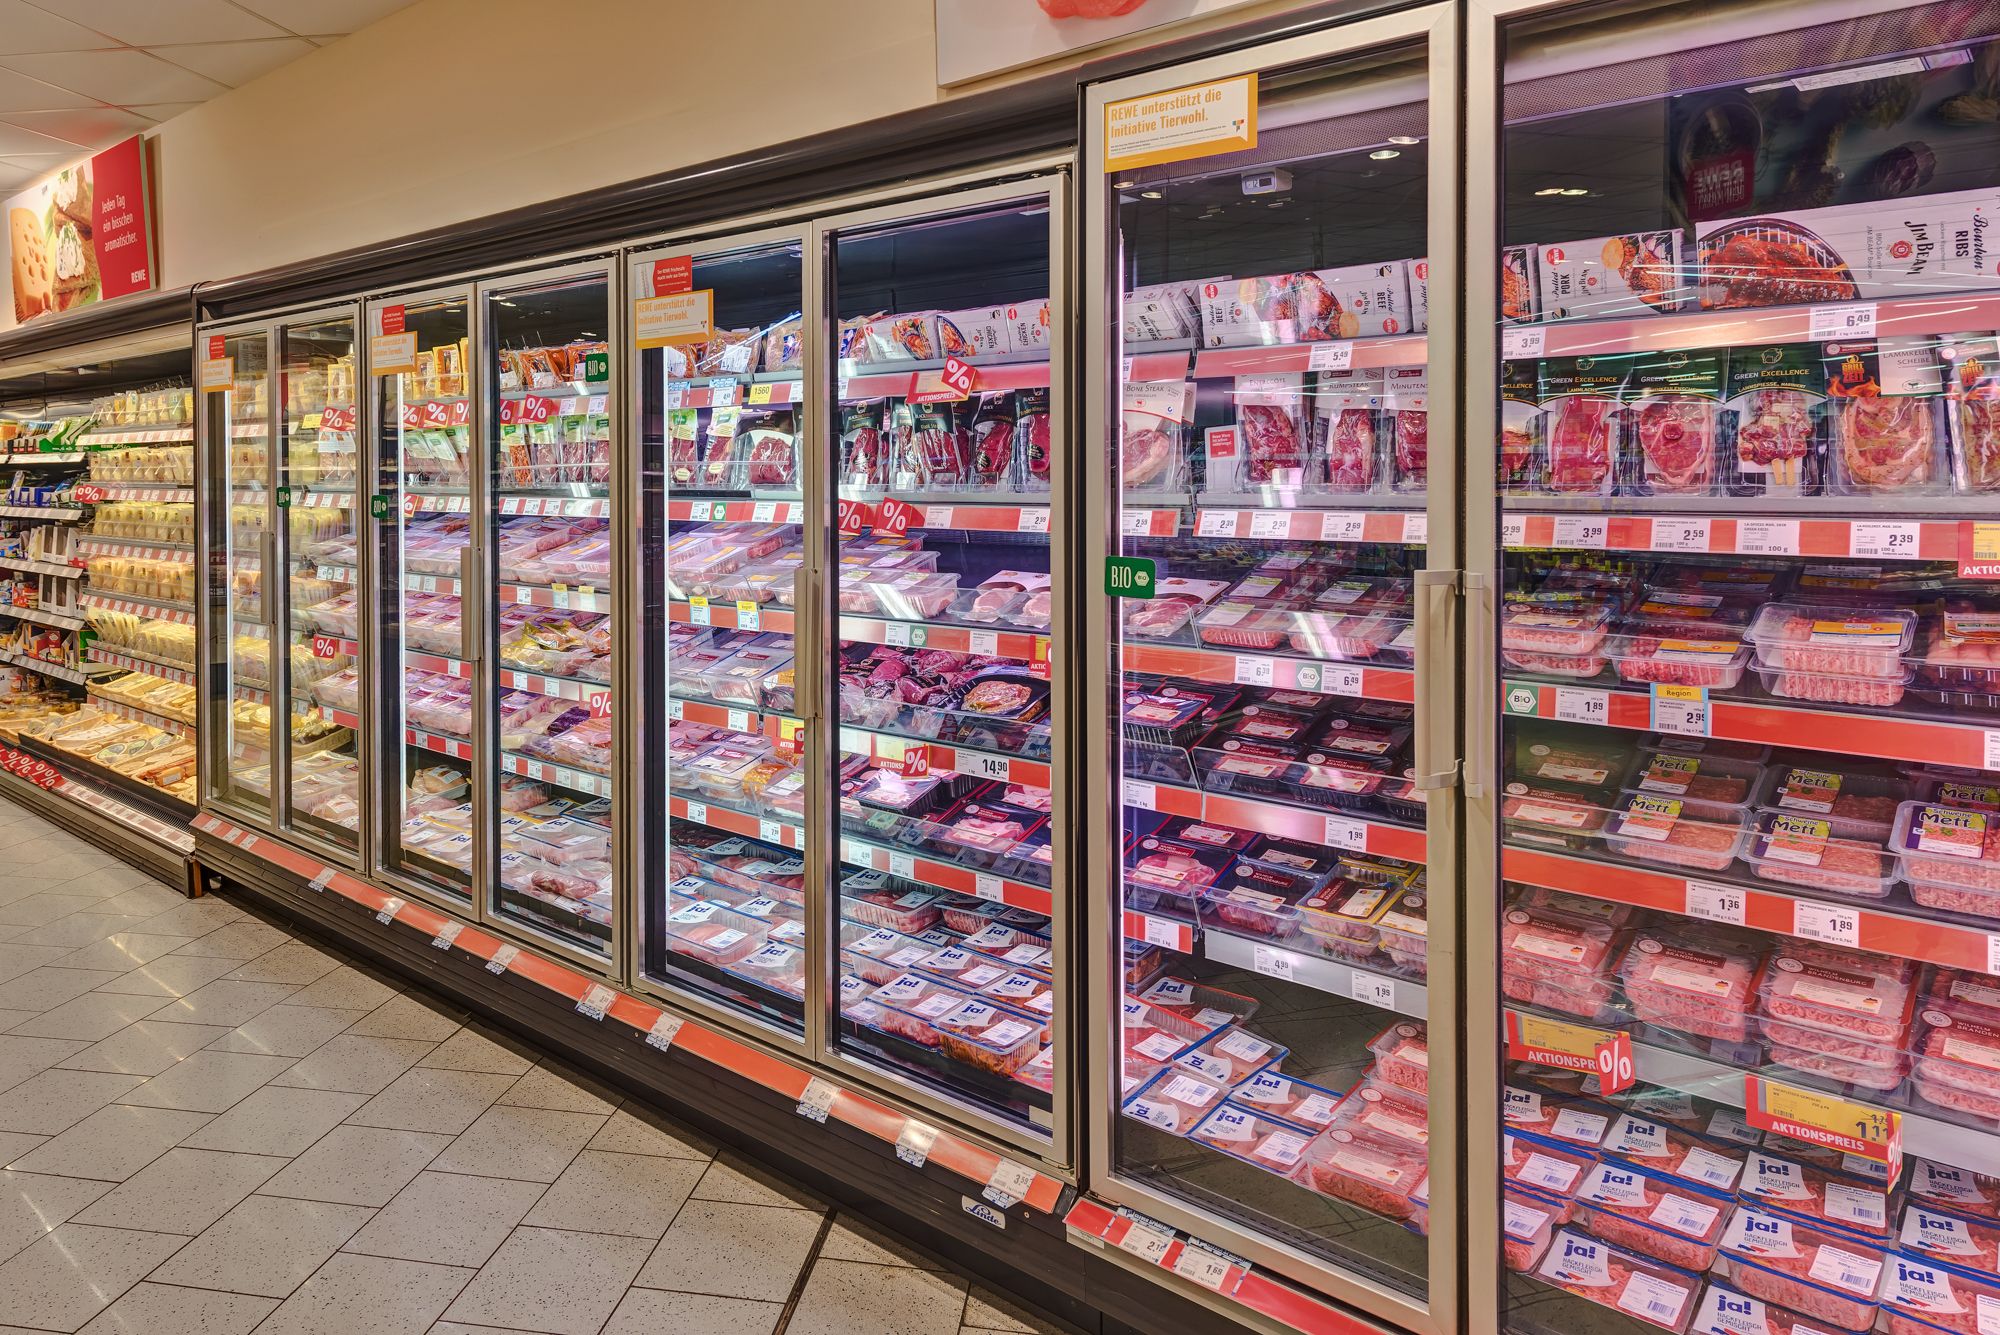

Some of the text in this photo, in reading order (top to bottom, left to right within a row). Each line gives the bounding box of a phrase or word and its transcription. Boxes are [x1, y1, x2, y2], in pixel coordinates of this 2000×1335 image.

[1112, 89, 1222, 121] REWE unterstützt die
[1112, 108, 1208, 138] Initiative Tierwohl.
[102, 195, 126, 214] Jeden Tag
[112, 212, 134, 230] bisschen
[104, 231, 138, 252] aromatischer.
[1904, 221, 1934, 276] JIM BEAM
[1956, 230, 1968, 258] RIBS
[1974, 214, 1988, 270] Bourbon
[131, 269, 146, 284] REWE
[1561, 274, 1570, 294] PORK
[654, 299, 685, 310] unterstützt
[687, 297, 695, 306] die
[1377, 292, 1386, 308] BEEF
[986, 326, 994, 348] CHICKEN
[1020, 322, 1028, 346] CHICKEN
[1522, 338, 1540, 348] 3.99
[1333, 352, 1348, 361] 5.49
[588, 360, 598, 375] BIO
[946, 360, 969, 389] %
[1734, 369, 1810, 380] GREEN EXCELLENCE
[1843, 372, 1864, 382] ZEIT
[918, 392, 956, 402] AKTIONSPREIS
[428, 404, 447, 420] %
[527, 397, 545, 419] %
[325, 409, 344, 427] %
[883, 502, 905, 530] %
[1582, 528, 1602, 538] 3.99
[1683, 530, 1704, 541] 2.59
[1889, 534, 1913, 547] 2.39
[1112, 566, 1132, 588] BIO
[316, 639, 334, 655] %
[1344, 676, 1359, 686] 6.49
[1585, 702, 1603, 713] 1.89
[906, 750, 926, 773] %
[982, 759, 1008, 774] 14.90
[1650, 758, 1687, 772] Mett
[1786, 773, 1829, 787] Mett
[1798, 770, 1830, 778] Schweine
[1642, 795, 1672, 805] Schweine
[1938, 788, 1985, 802] Mett
[1630, 799, 1668, 813] Mett
[1934, 808, 1972, 818] Schweine
[1772, 820, 1816, 835] Mett
[1785, 816, 1818, 826] Schweine
[1920, 813, 1970, 828] Mett
[1348, 830, 1363, 842] 1.99
[857, 870, 881, 880] ja!
[687, 904, 709, 914] ja!
[1719, 899, 1740, 912] 1.36
[986, 926, 1009, 937] ja!
[1531, 922, 1578, 935] BRANDENBURG
[1829, 919, 1853, 932] 1.89
[760, 944, 787, 956] ja!
[941, 949, 963, 960] ja!
[1275, 959, 1289, 970] 4.99
[1665, 951, 1719, 966] BRANDENBURG
[1807, 970, 1867, 986] BRANDENBURG
[1808, 967, 1838, 977] WILHELM
[895, 976, 920, 988] ja!
[1005, 975, 1030, 987] ja!
[1156, 982, 1185, 994] ja!
[1375, 986, 1390, 998] 1.99
[962, 1003, 987, 1015] ja!
[1957, 1021, 1991, 1032] WILHELM
[1957, 1025, 2000, 1038] BRANDEN
[1600, 1040, 1631, 1090] %
[1253, 1075, 1280, 1088] ja!
[1382, 1101, 1425, 1118] BRANDENBURG
[1626, 1121, 1655, 1136] ja!
[1772, 1121, 1864, 1151] AKTIONSPREIS
[1353, 1142, 1397, 1159] BRANDENBURG
[1758, 1159, 1790, 1176] ja!
[1928, 1165, 1960, 1181] ja!
[1014, 1174, 1028, 1186] 3.59
[1602, 1170, 1633, 1186] ja!
[1759, 1175, 1800, 1188] HACKFLEISCH
[1760, 1180, 1790, 1191] GEMISCHT
[966, 1204, 1000, 1225] Linde
[1746, 1216, 1778, 1233] ja!
[1919, 1214, 1953, 1231] ja!
[1744, 1232, 1788, 1247] HACKFLEISCH
[1744, 1237, 1776, 1248] GEMISCHT
[1920, 1230, 1967, 1244] HACKFLEISCH
[1921, 1235, 1956, 1246] GEMISCHT
[1564, 1239, 1596, 1259] ja!
[1206, 1264, 1223, 1276] 1.69
[1562, 1258, 1602, 1272] HACKFLEISCH
[1562, 1262, 1592, 1276] GEMISCHT
[1898, 1264, 1935, 1284] ja!
[1900, 1282, 1948, 1300] HACKFLEISCH
[1900, 1288, 1936, 1301] GEMISCHT
[1717, 1295, 1751, 1316] ja!
[1717, 1312, 1762, 1330] HACKFLEISCH
